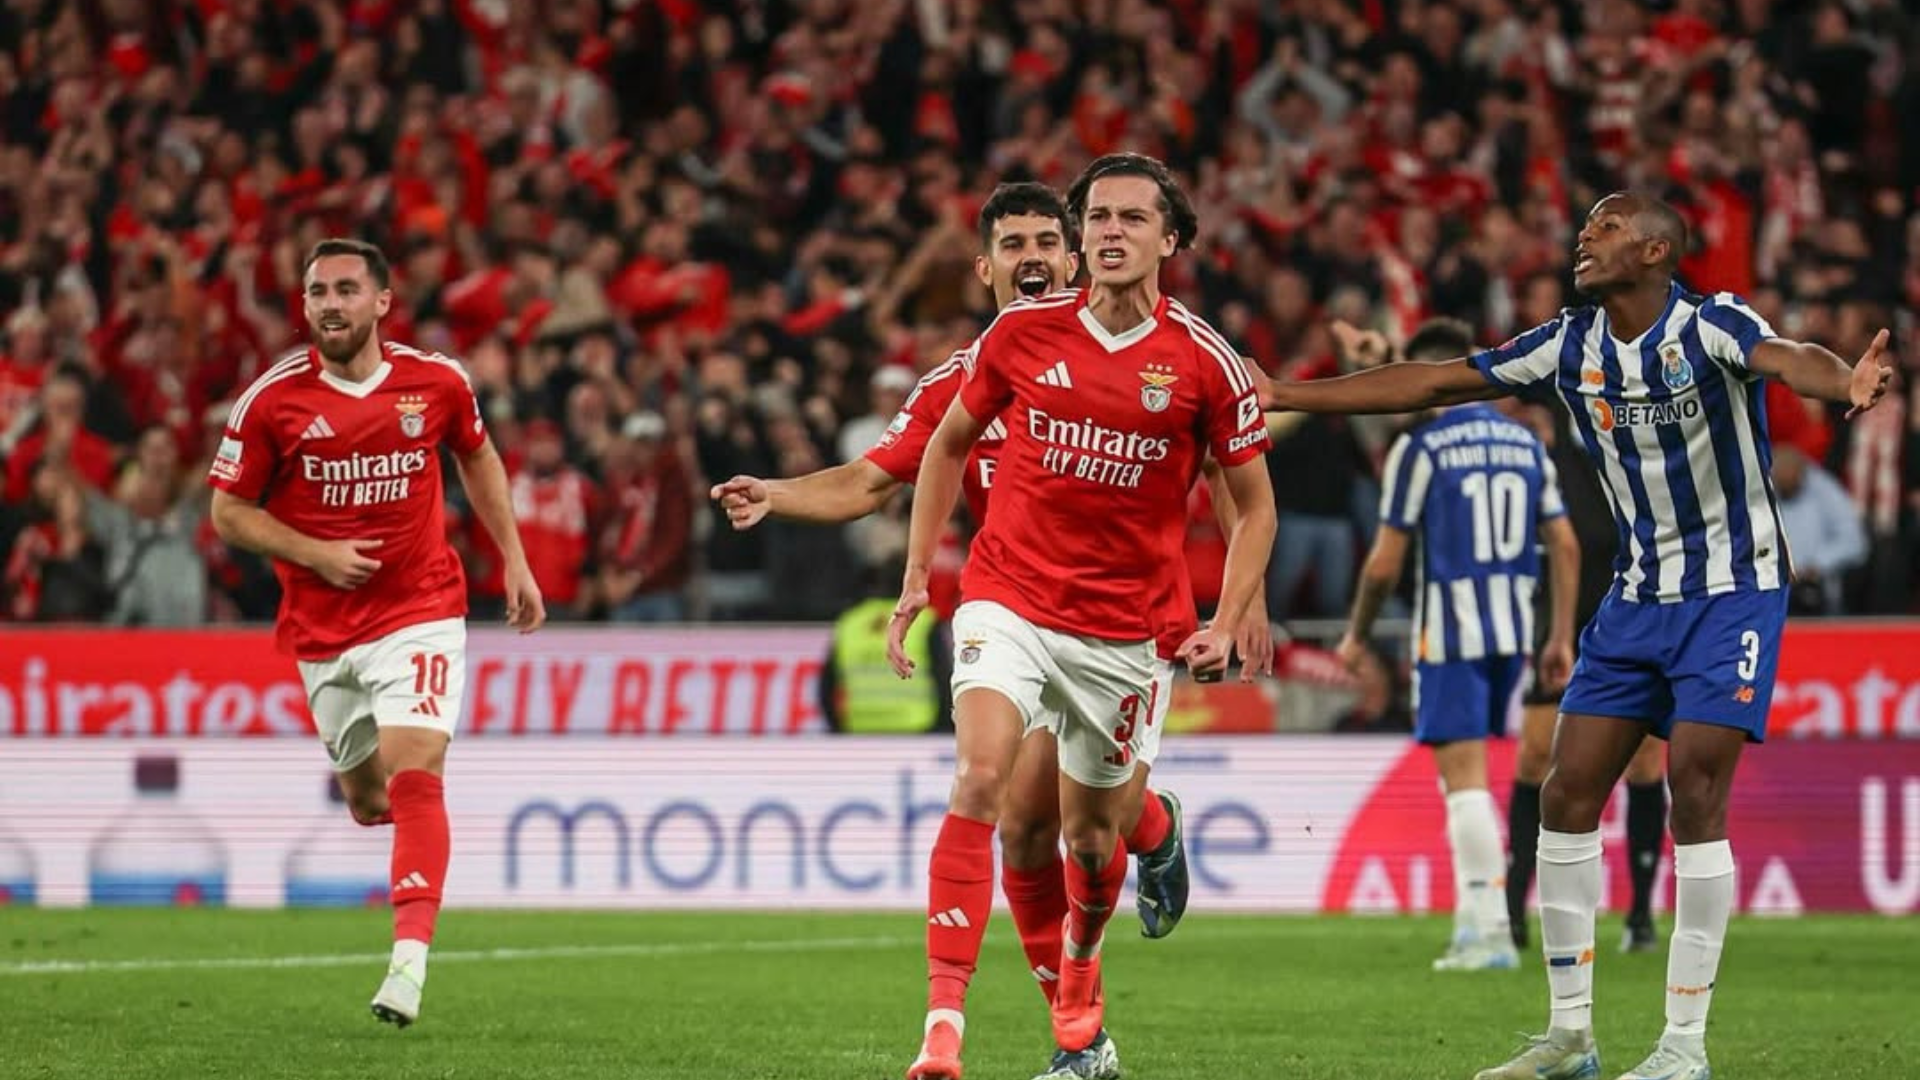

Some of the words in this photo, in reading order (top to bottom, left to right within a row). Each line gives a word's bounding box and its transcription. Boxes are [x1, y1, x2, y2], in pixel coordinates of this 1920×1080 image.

[1028, 407, 1170, 462] Emirates
[1613, 399, 1698, 428] BETANO
[1228, 426, 1269, 453] Betan
[302, 449, 426, 482] Emirates
[1043, 447, 1069, 477] FLY
[1074, 455, 1144, 489] BETTER
[322, 483, 349, 507] FLY
[353, 477, 410, 506] BETTER
[1461, 471, 1529, 563] 10
[411, 653, 449, 697] 10
[1738, 630, 1760, 681] 3
[604, 658, 826, 735] BETTE
[1114, 692, 1139, 742] 3
[504, 768, 1270, 891] monche
